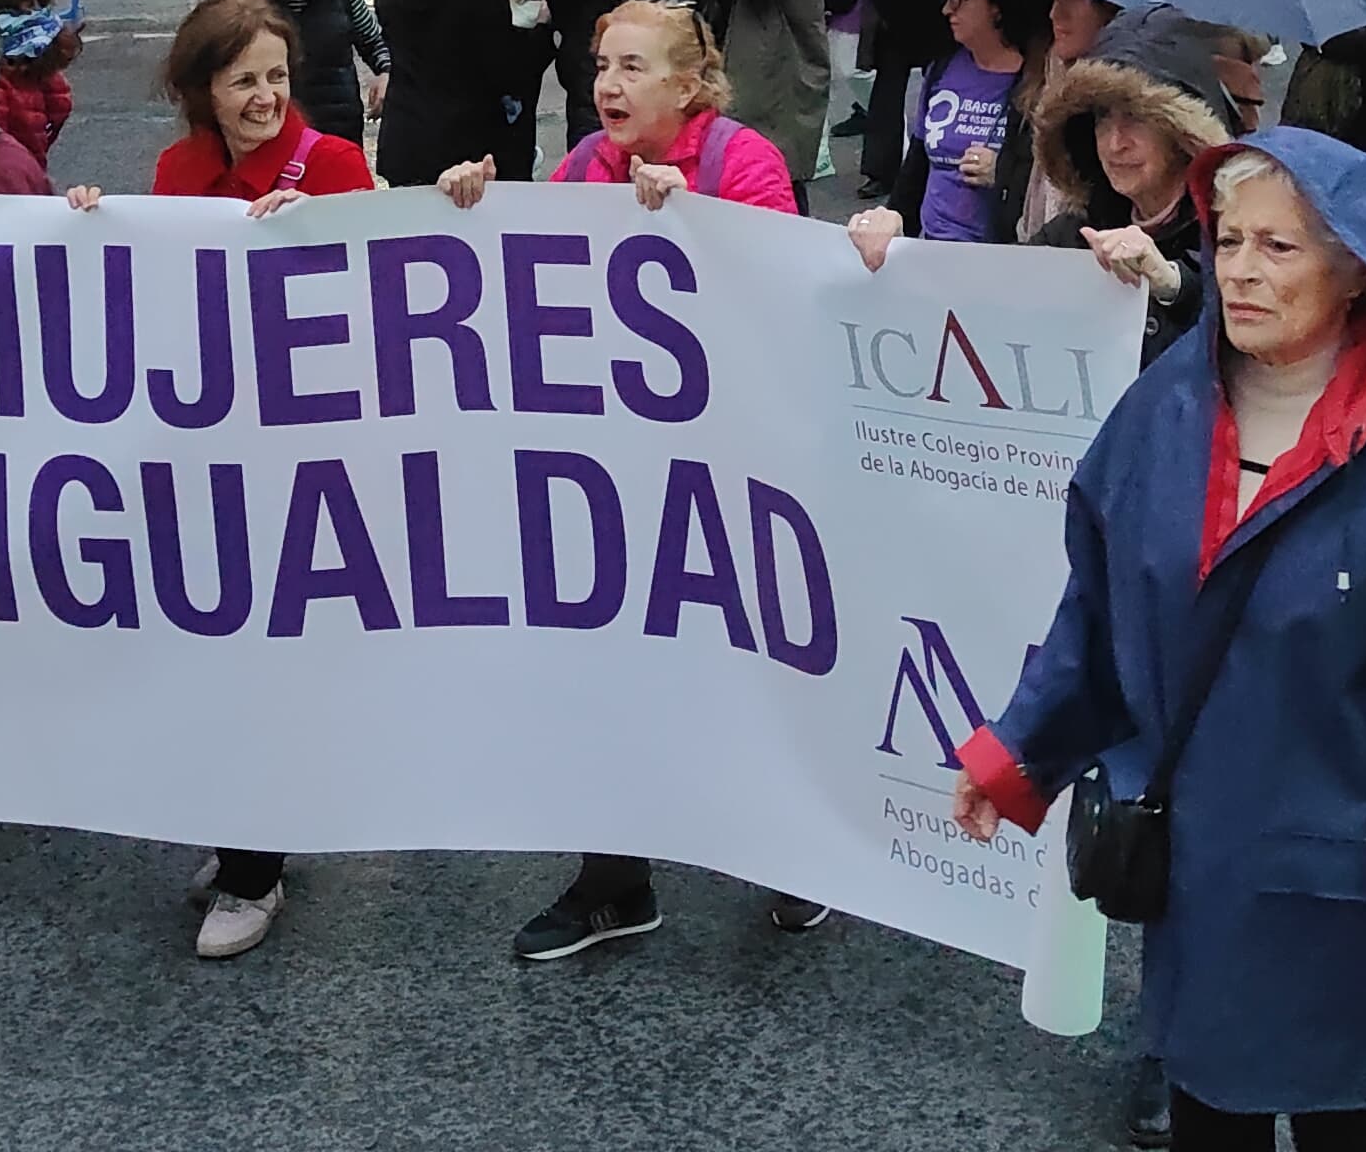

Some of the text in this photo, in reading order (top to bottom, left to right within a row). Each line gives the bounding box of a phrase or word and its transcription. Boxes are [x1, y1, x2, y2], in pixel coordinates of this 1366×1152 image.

[838, 308, 1104, 423] ICALI
[854, 420, 1082, 474] Ilustre Colegio Provin
[860, 452, 1069, 504] de la Abogacía de Alic
[889, 838, 1015, 900] Abogadas
